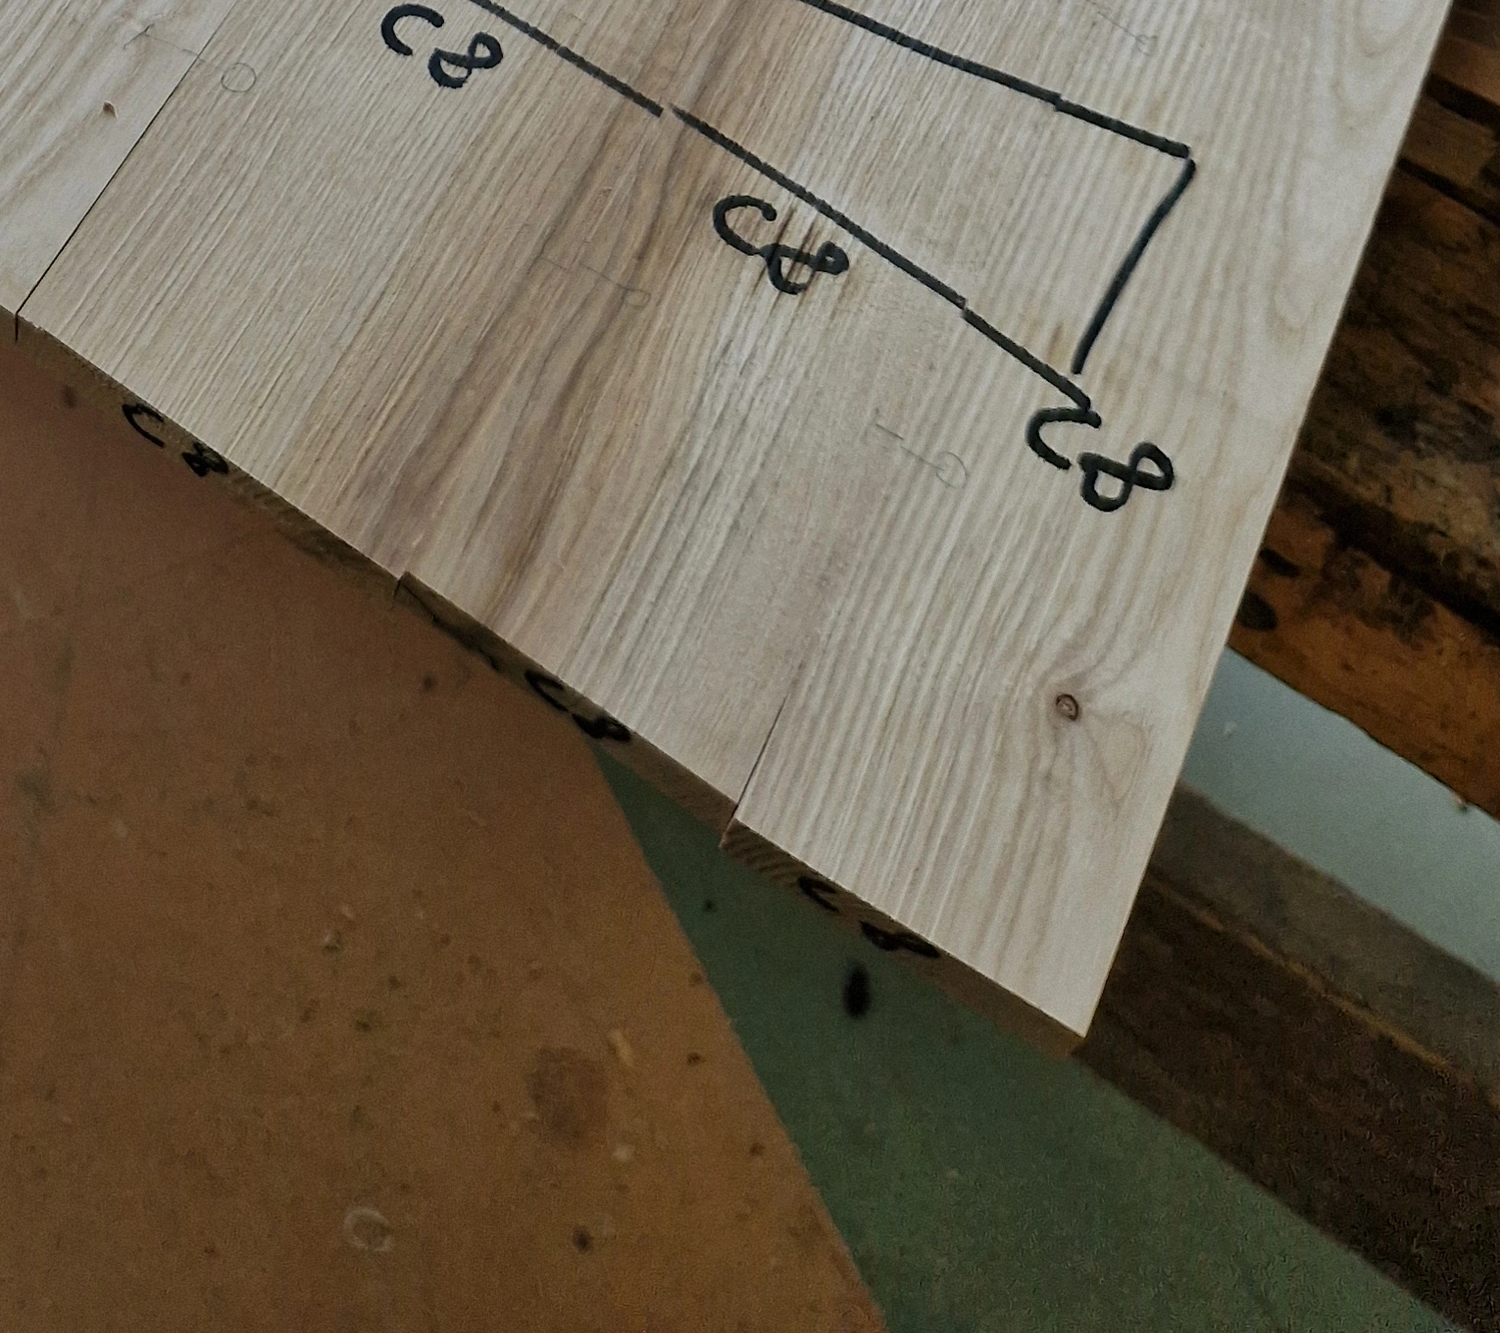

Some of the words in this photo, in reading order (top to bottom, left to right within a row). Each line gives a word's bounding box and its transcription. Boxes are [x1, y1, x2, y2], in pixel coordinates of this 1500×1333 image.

[381, 3, 504, 89] C8
[712, 194, 850, 295] C8
[1025, 406, 1175, 513] C8
